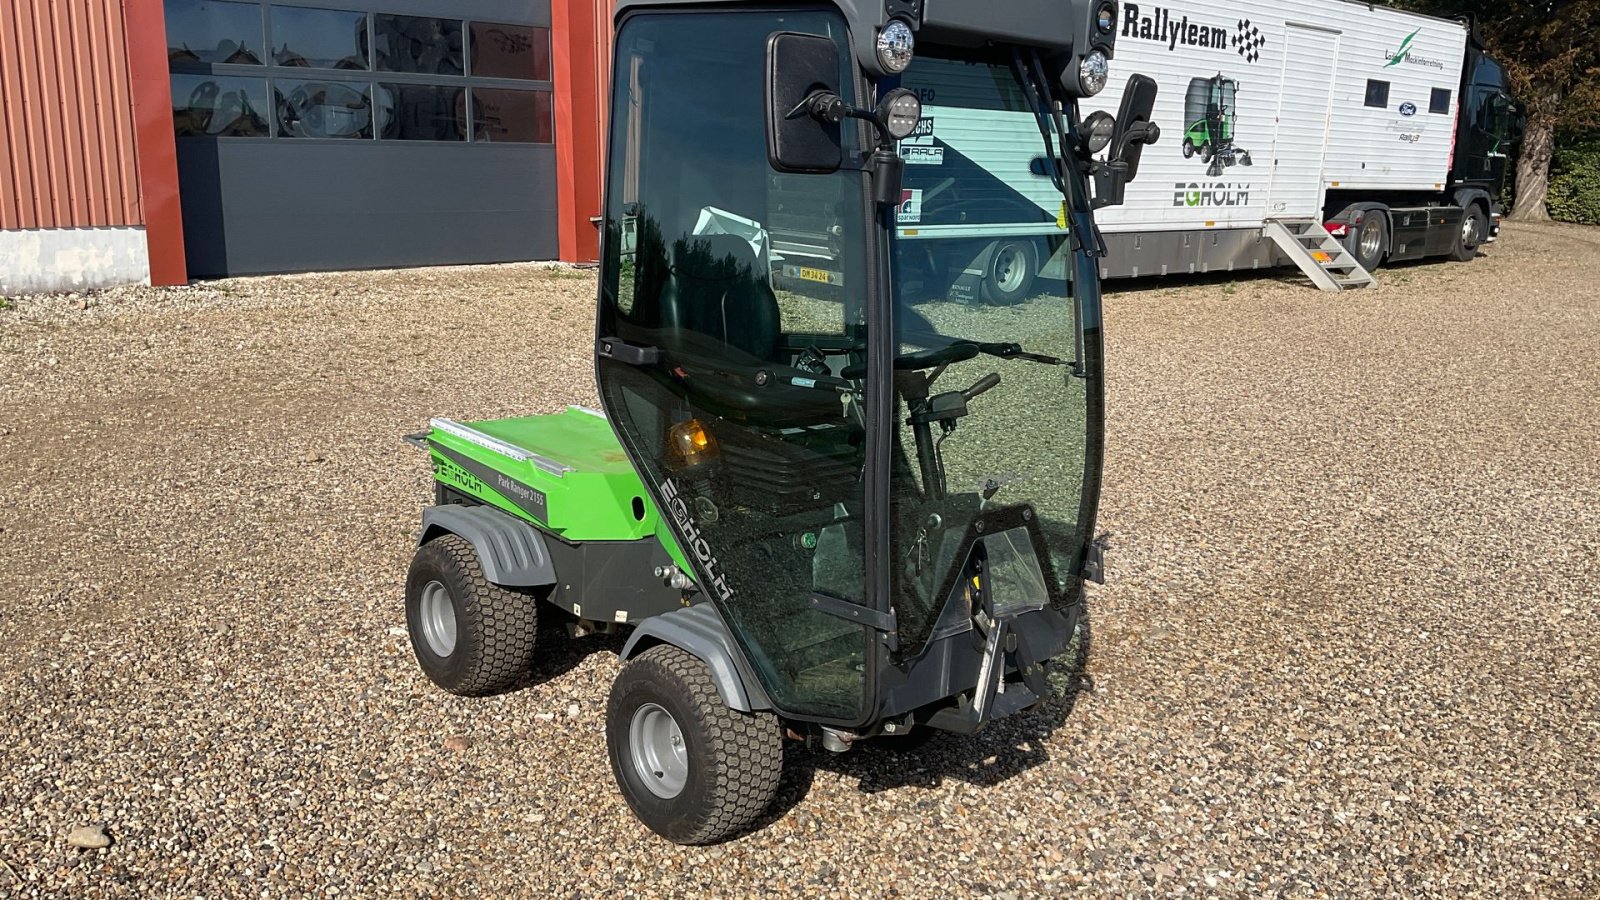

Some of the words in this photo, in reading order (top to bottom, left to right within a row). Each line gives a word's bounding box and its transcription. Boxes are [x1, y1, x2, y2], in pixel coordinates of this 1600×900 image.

[1121, 2, 1227, 51] Rallyteam
[1173, 182, 1250, 206] EGHOLM
[441, 462, 482, 493] EGHOLM
[498, 474, 510, 489] Park
[510, 480, 530, 499] Ranger
[530, 489, 544, 506] 2155
[660, 477, 735, 601] EGHOLM
